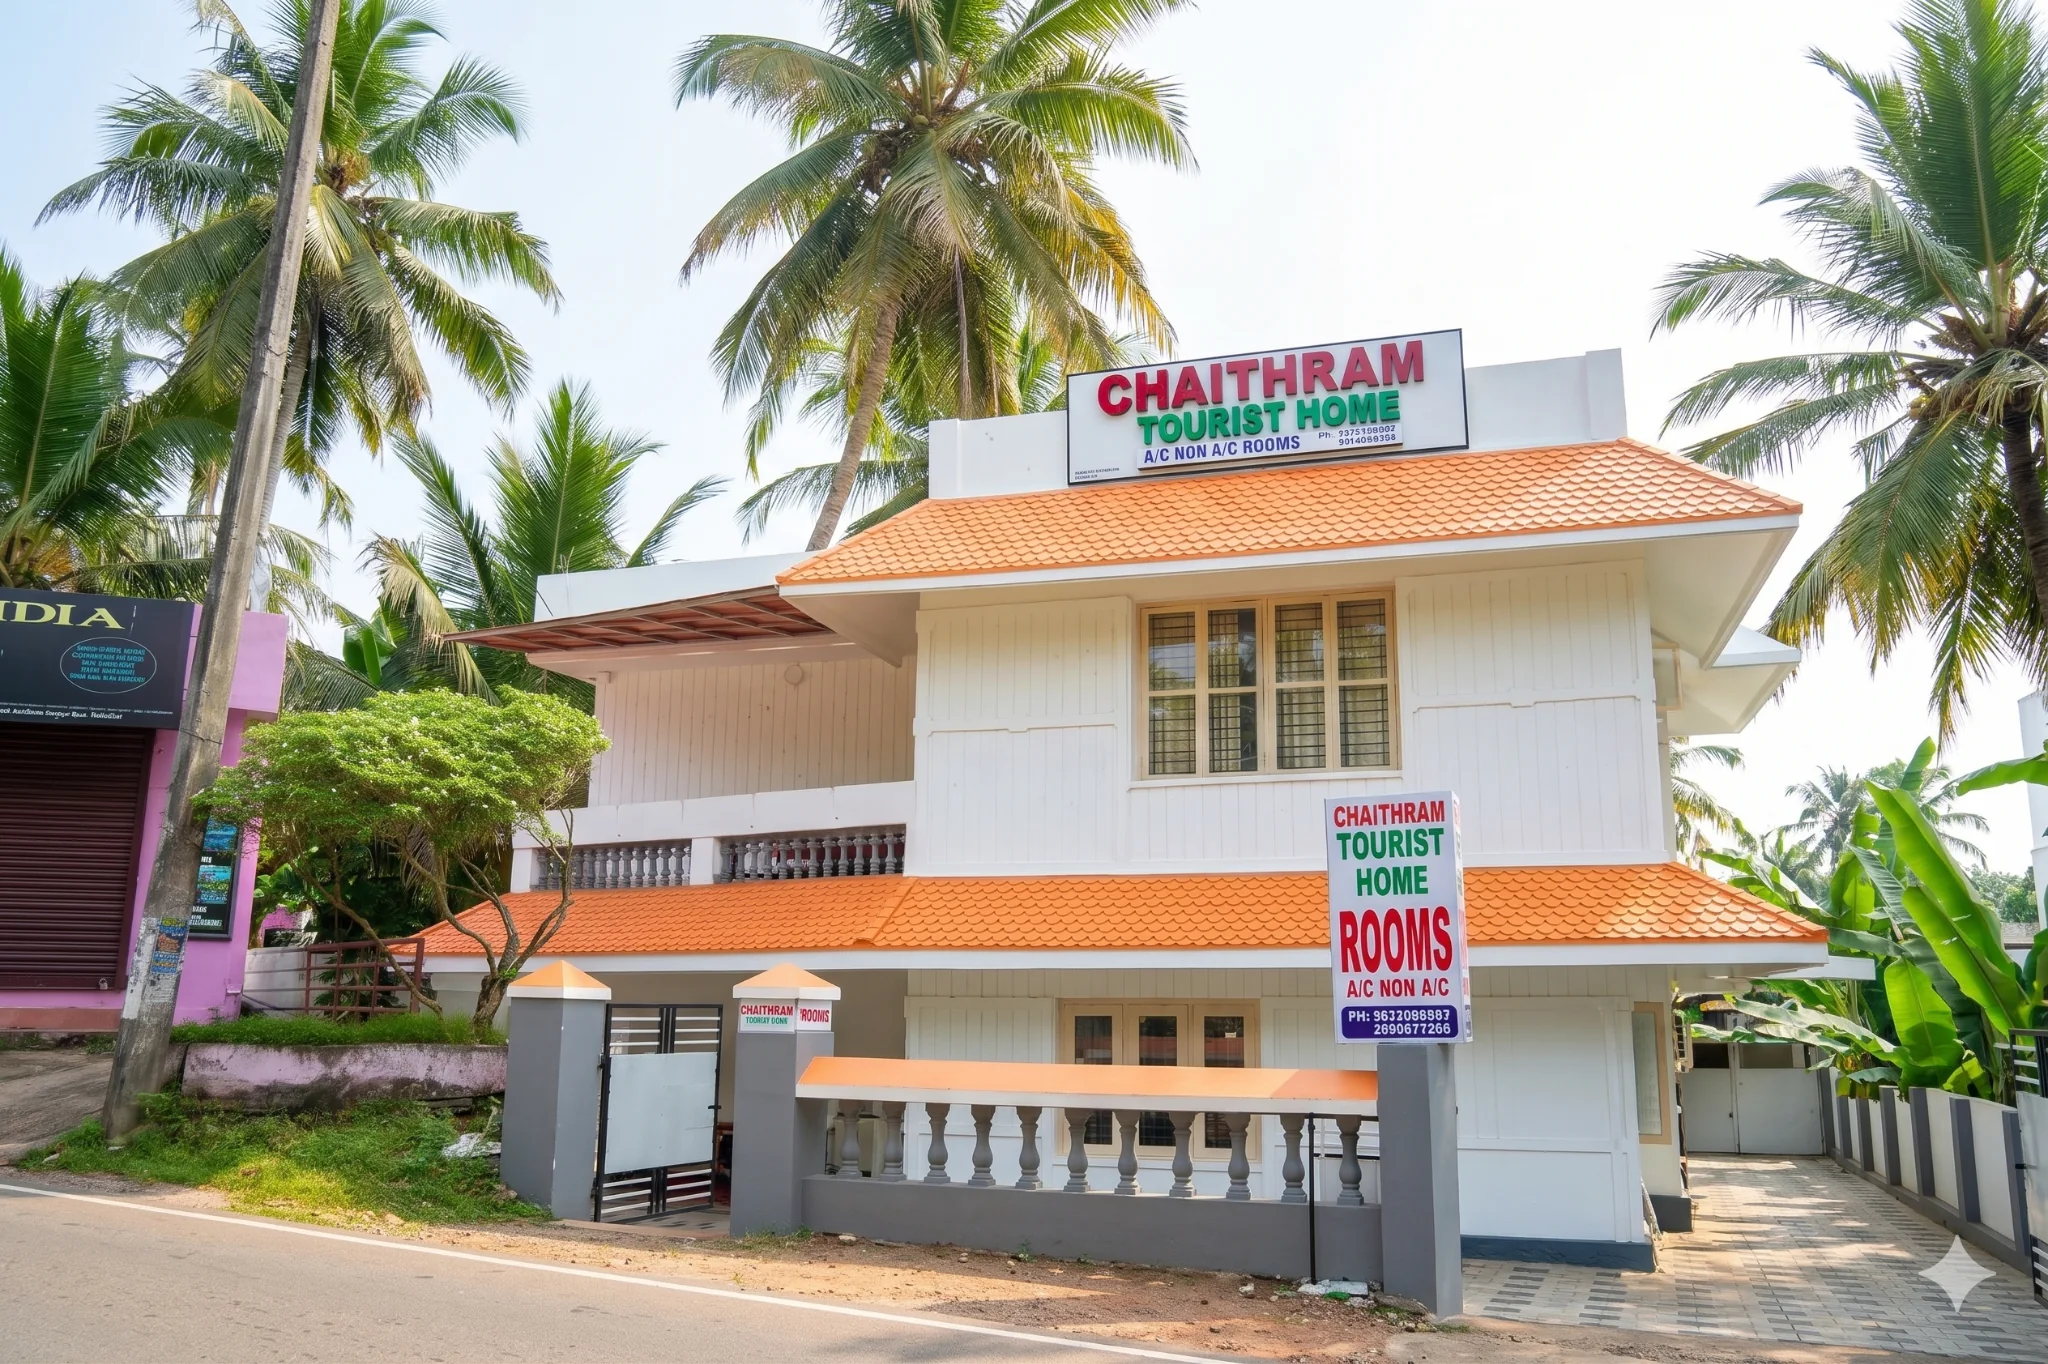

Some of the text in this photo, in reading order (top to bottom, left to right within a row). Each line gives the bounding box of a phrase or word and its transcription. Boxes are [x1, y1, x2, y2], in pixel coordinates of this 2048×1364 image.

[1097, 340, 1424, 416] CHAITHRAM
[1136, 390, 1401, 445] TOURIST HOME
[1143, 435, 1301, 465] A/C NON A/C ROOMS
[0, 600, 126, 630] DIA
[1333, 800, 1446, 828] CHAITHRAM
[1336, 827, 1445, 861] TOURIST
[1356, 865, 1429, 897] HOME
[1338, 905, 1453, 974] ROOMS
[1346, 977, 1450, 998] A/C NON A/C
[740, 1004, 794, 1016] CHAITHRAM
[1348, 1010, 1371, 1022] PH:
[1373, 1022, 1452, 1035] 2690677266
